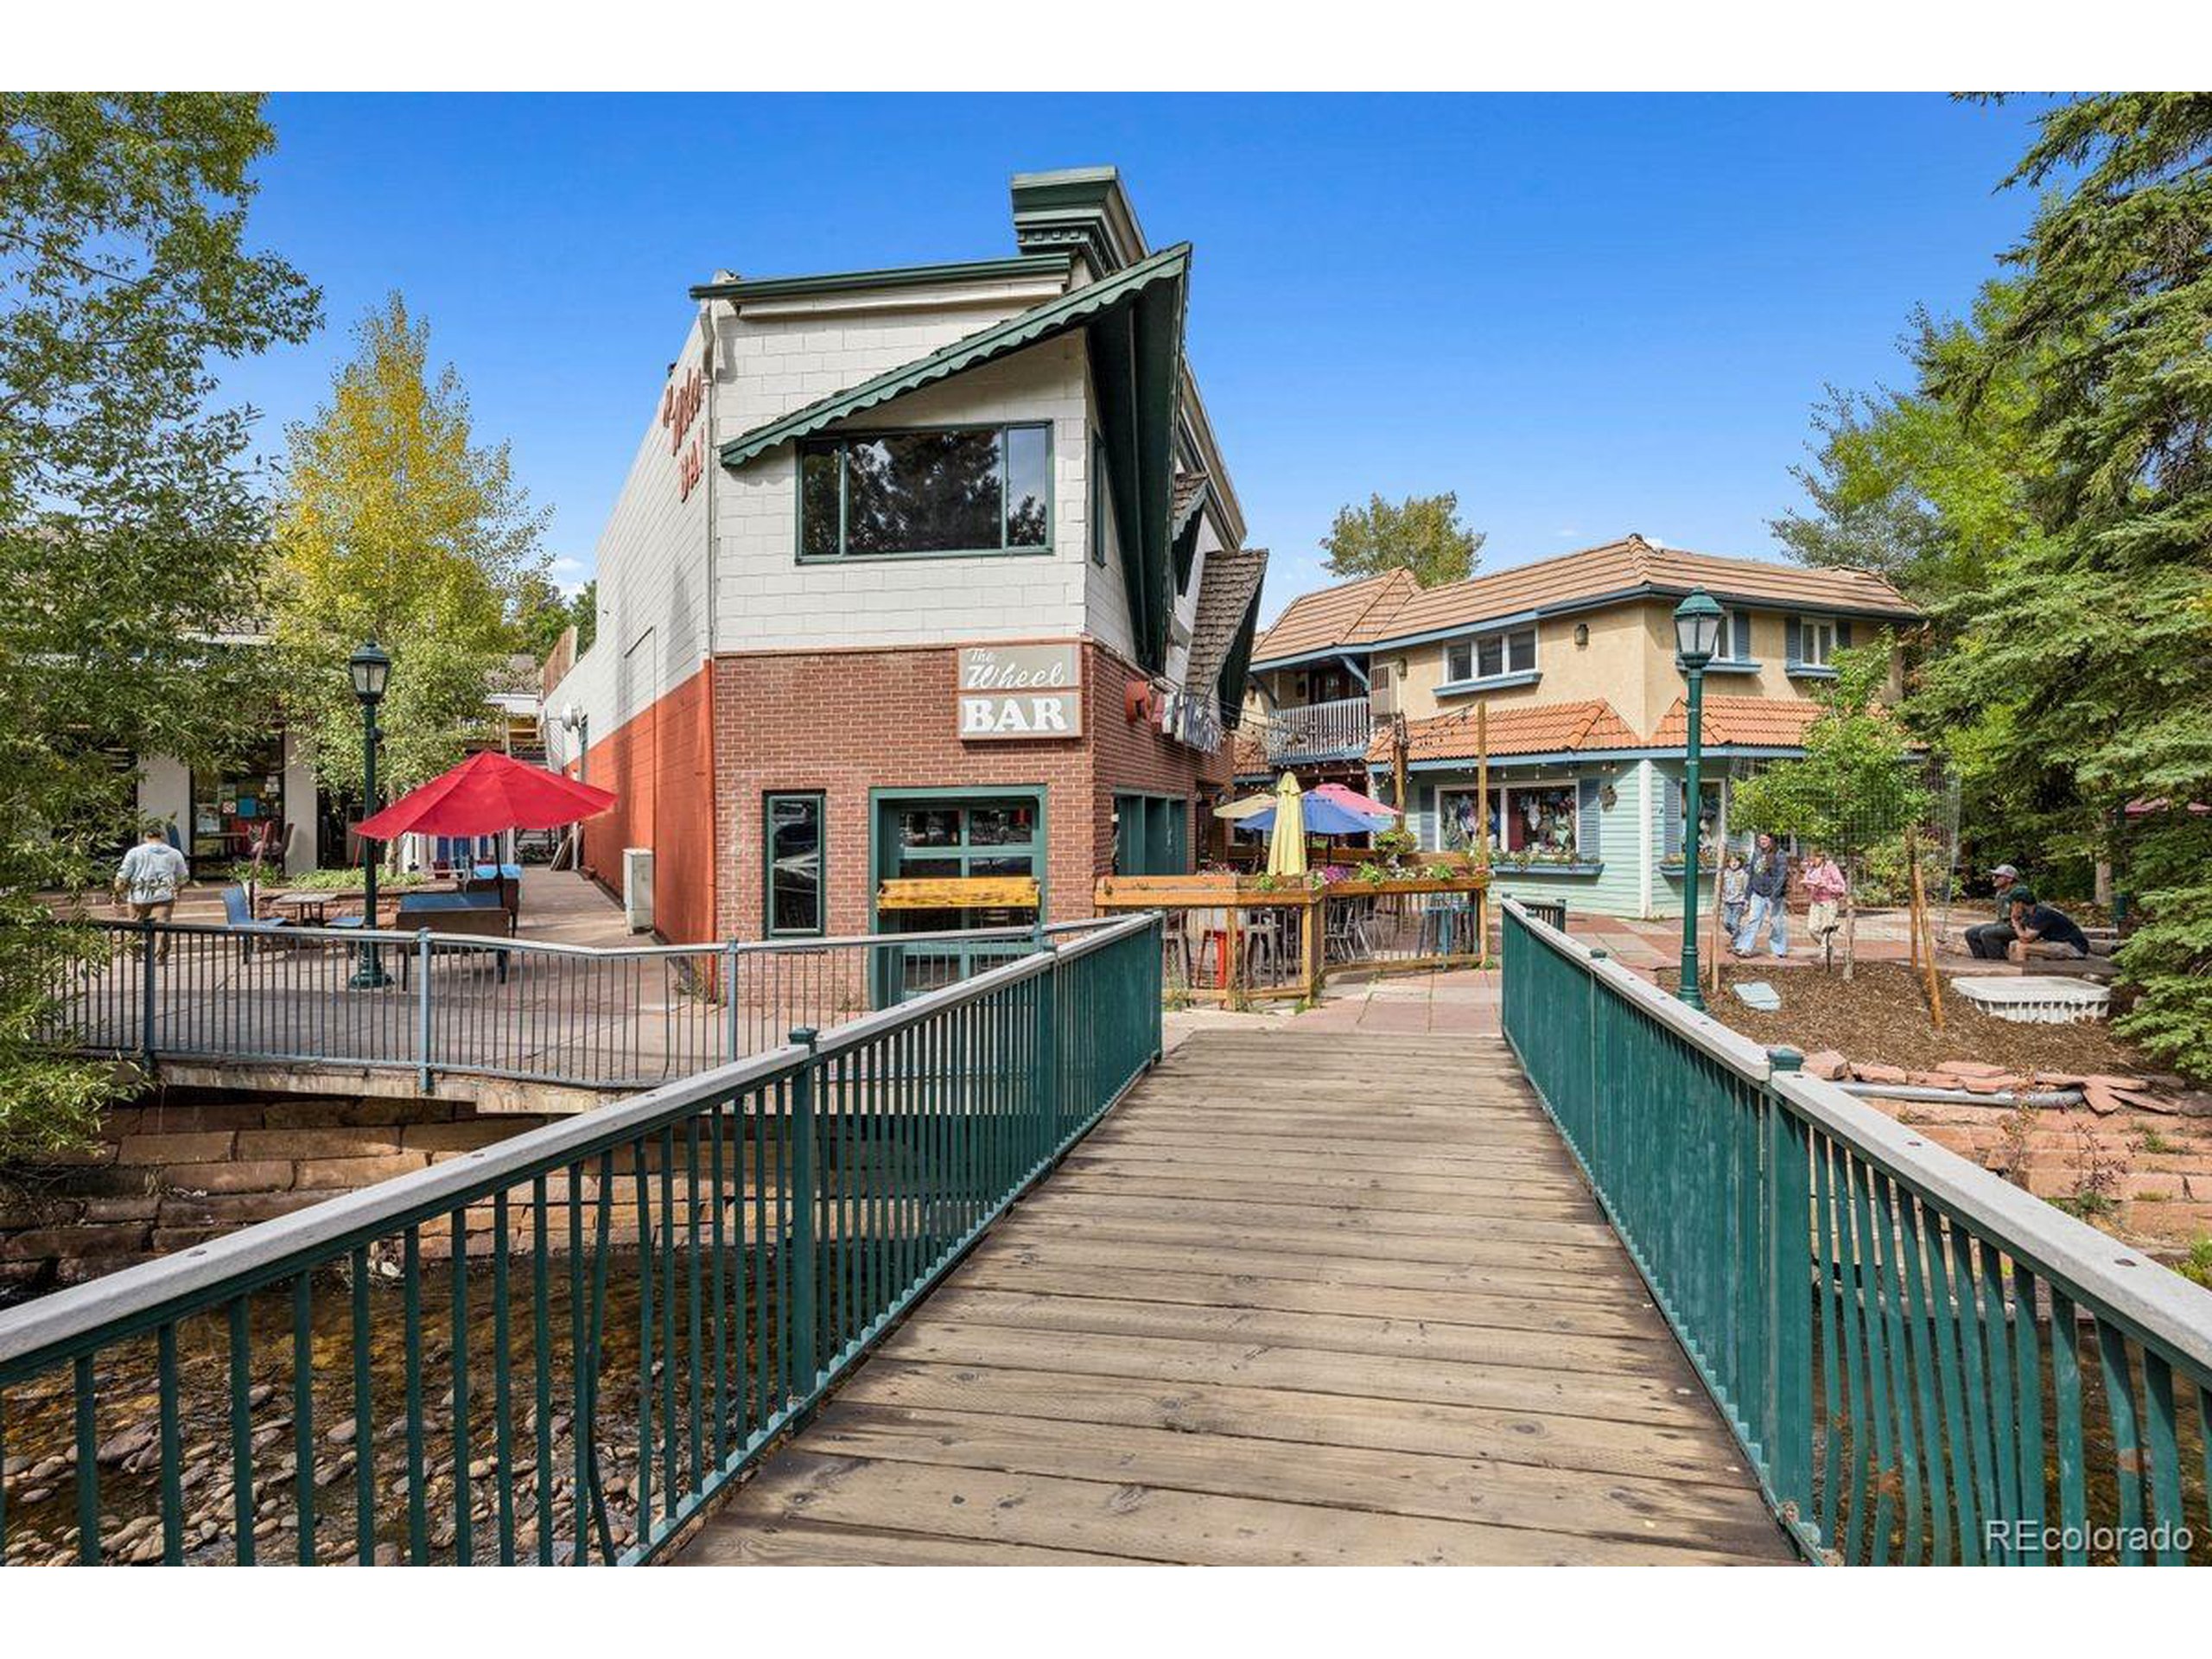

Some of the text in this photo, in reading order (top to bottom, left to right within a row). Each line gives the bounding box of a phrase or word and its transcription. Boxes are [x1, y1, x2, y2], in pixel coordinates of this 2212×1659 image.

[966, 647, 994, 663] The
[967, 661, 1065, 689] Wheel
[963, 697, 1067, 733] BAR
